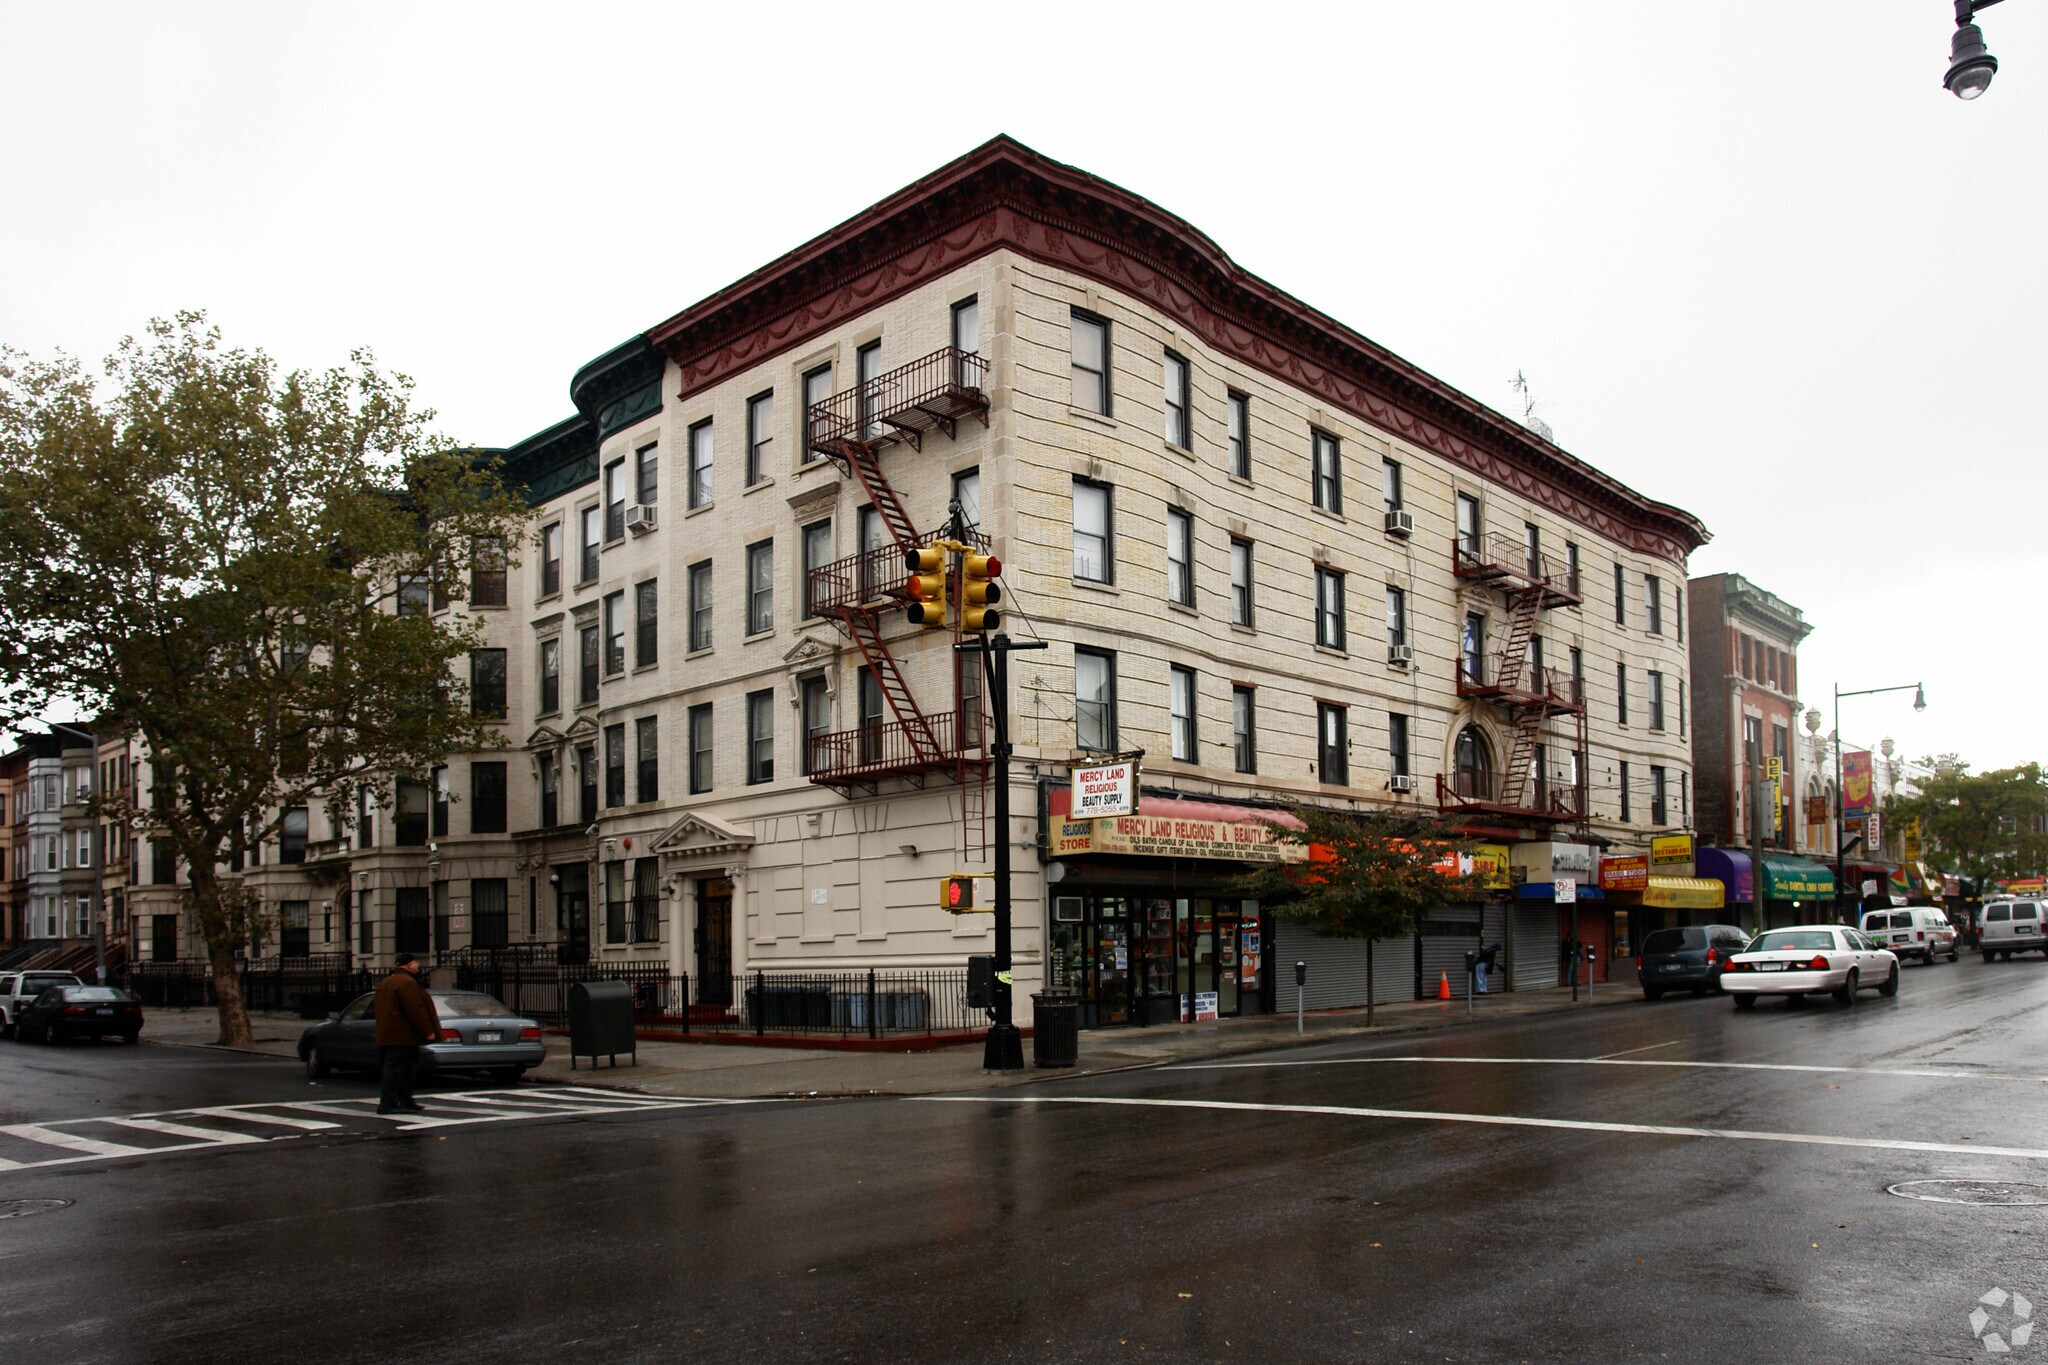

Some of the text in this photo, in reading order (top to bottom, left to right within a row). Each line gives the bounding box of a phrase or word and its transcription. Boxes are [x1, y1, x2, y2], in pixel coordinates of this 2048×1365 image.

[1080, 768, 1124, 783] MERCY LAND
[1084, 782, 1117, 794] RELIGIOUS
[1082, 793, 1122, 807] BEAUTY SUPPLY
[1086, 806, 1116, 815] 778-5255
[1062, 822, 1091, 836] RELIGIOUS
[1117, 818, 1146, 835] MERCY
[1150, 820, 1171, 836] LAND
[1175, 822, 1214, 840] RELIGIOUS
[1222, 826, 1227, 841] &
[1234, 827, 1261, 844] BEAUTY
[1870, 818, 1878, 845] BAKERY
[1060, 838, 1090, 850] STORE
[1129, 836, 1140, 844] OILS
[1142, 836, 1157, 845] BATHS
[1158, 837, 1176, 846] CANDLE
[1186, 840, 1194, 848] ALL
[1196, 841, 1209, 849] KINDS
[1212, 842, 1233, 850] COMPLETE
[1235, 843, 1251, 851] BEAUTY
[1253, 844, 1279, 853] ACCESSORIES
[1133, 844, 1154, 853] INCENSE
[1157, 846, 1167, 854] GIFT
[1185, 847, 1197, 855] BODY
[1209, 849, 1235, 857] FRAGRANCE
[1614, 857, 1638, 865] AFRICAN
[1628, 868, 1646, 876] STUDIO
